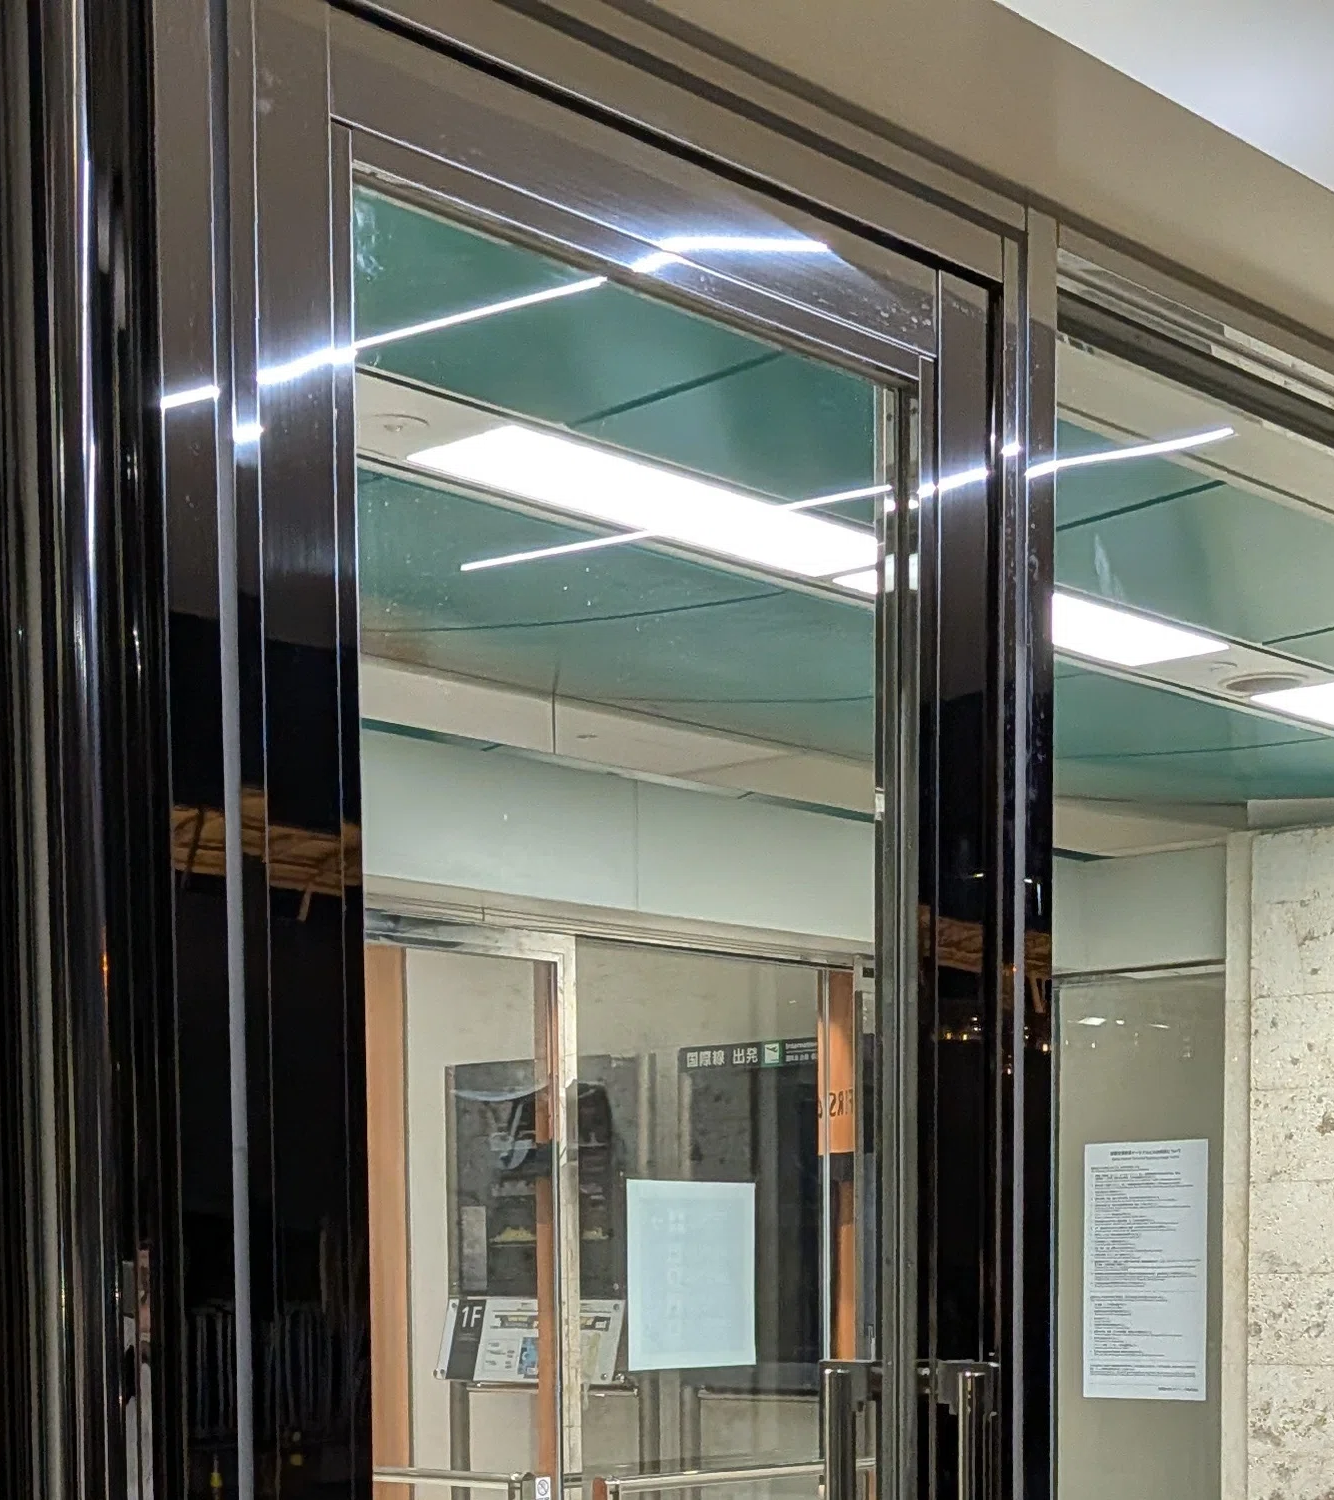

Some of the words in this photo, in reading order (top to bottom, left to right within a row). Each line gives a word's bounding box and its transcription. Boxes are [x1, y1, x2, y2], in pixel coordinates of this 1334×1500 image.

[686, 1050, 725, 1068] 国際線
[732, 1047, 759, 1065] 出発
[461, 1305, 483, 1328] 1F
